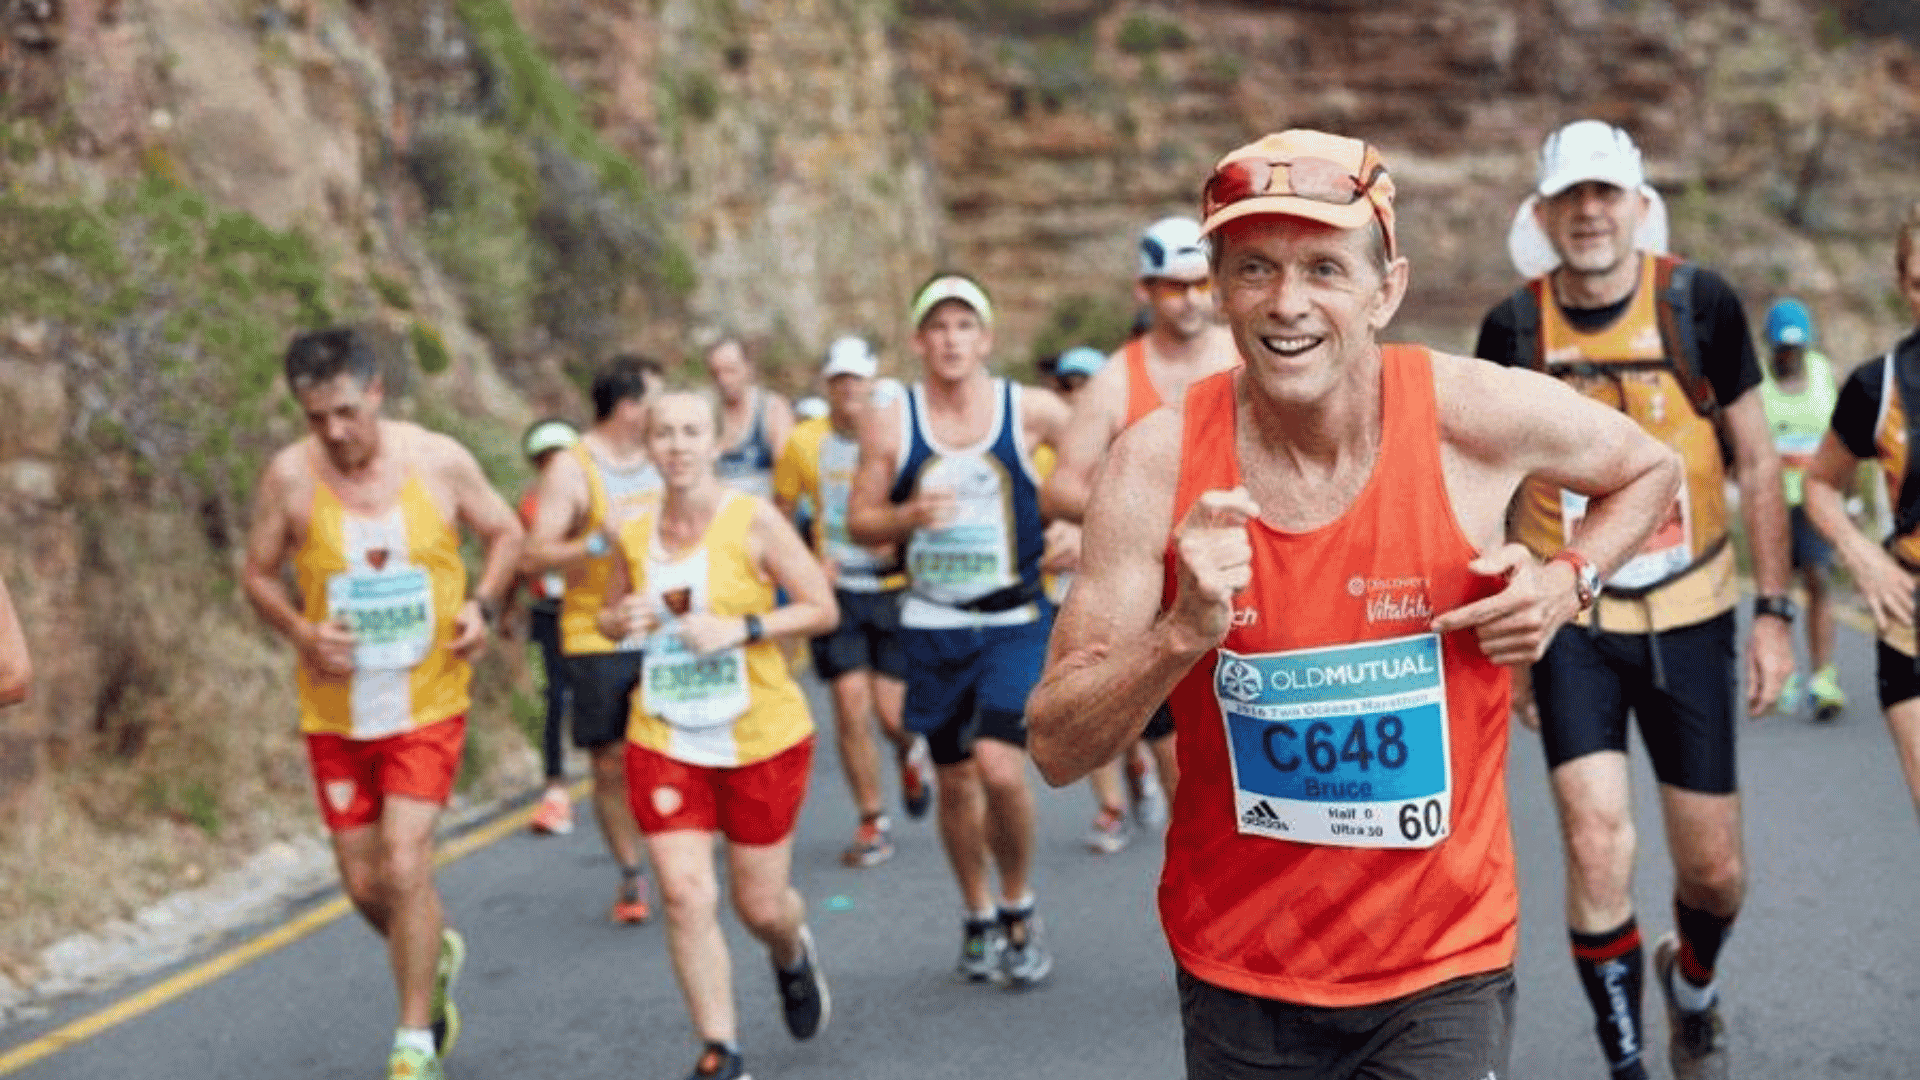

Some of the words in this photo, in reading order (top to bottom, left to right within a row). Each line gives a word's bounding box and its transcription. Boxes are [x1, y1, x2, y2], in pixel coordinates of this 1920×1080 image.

[1271, 654, 1434, 690] OLDMUTUAL
[1263, 716, 1408, 774] C648
[1305, 777, 1373, 798] Bruce
[1331, 823, 1364, 836] Ultra
